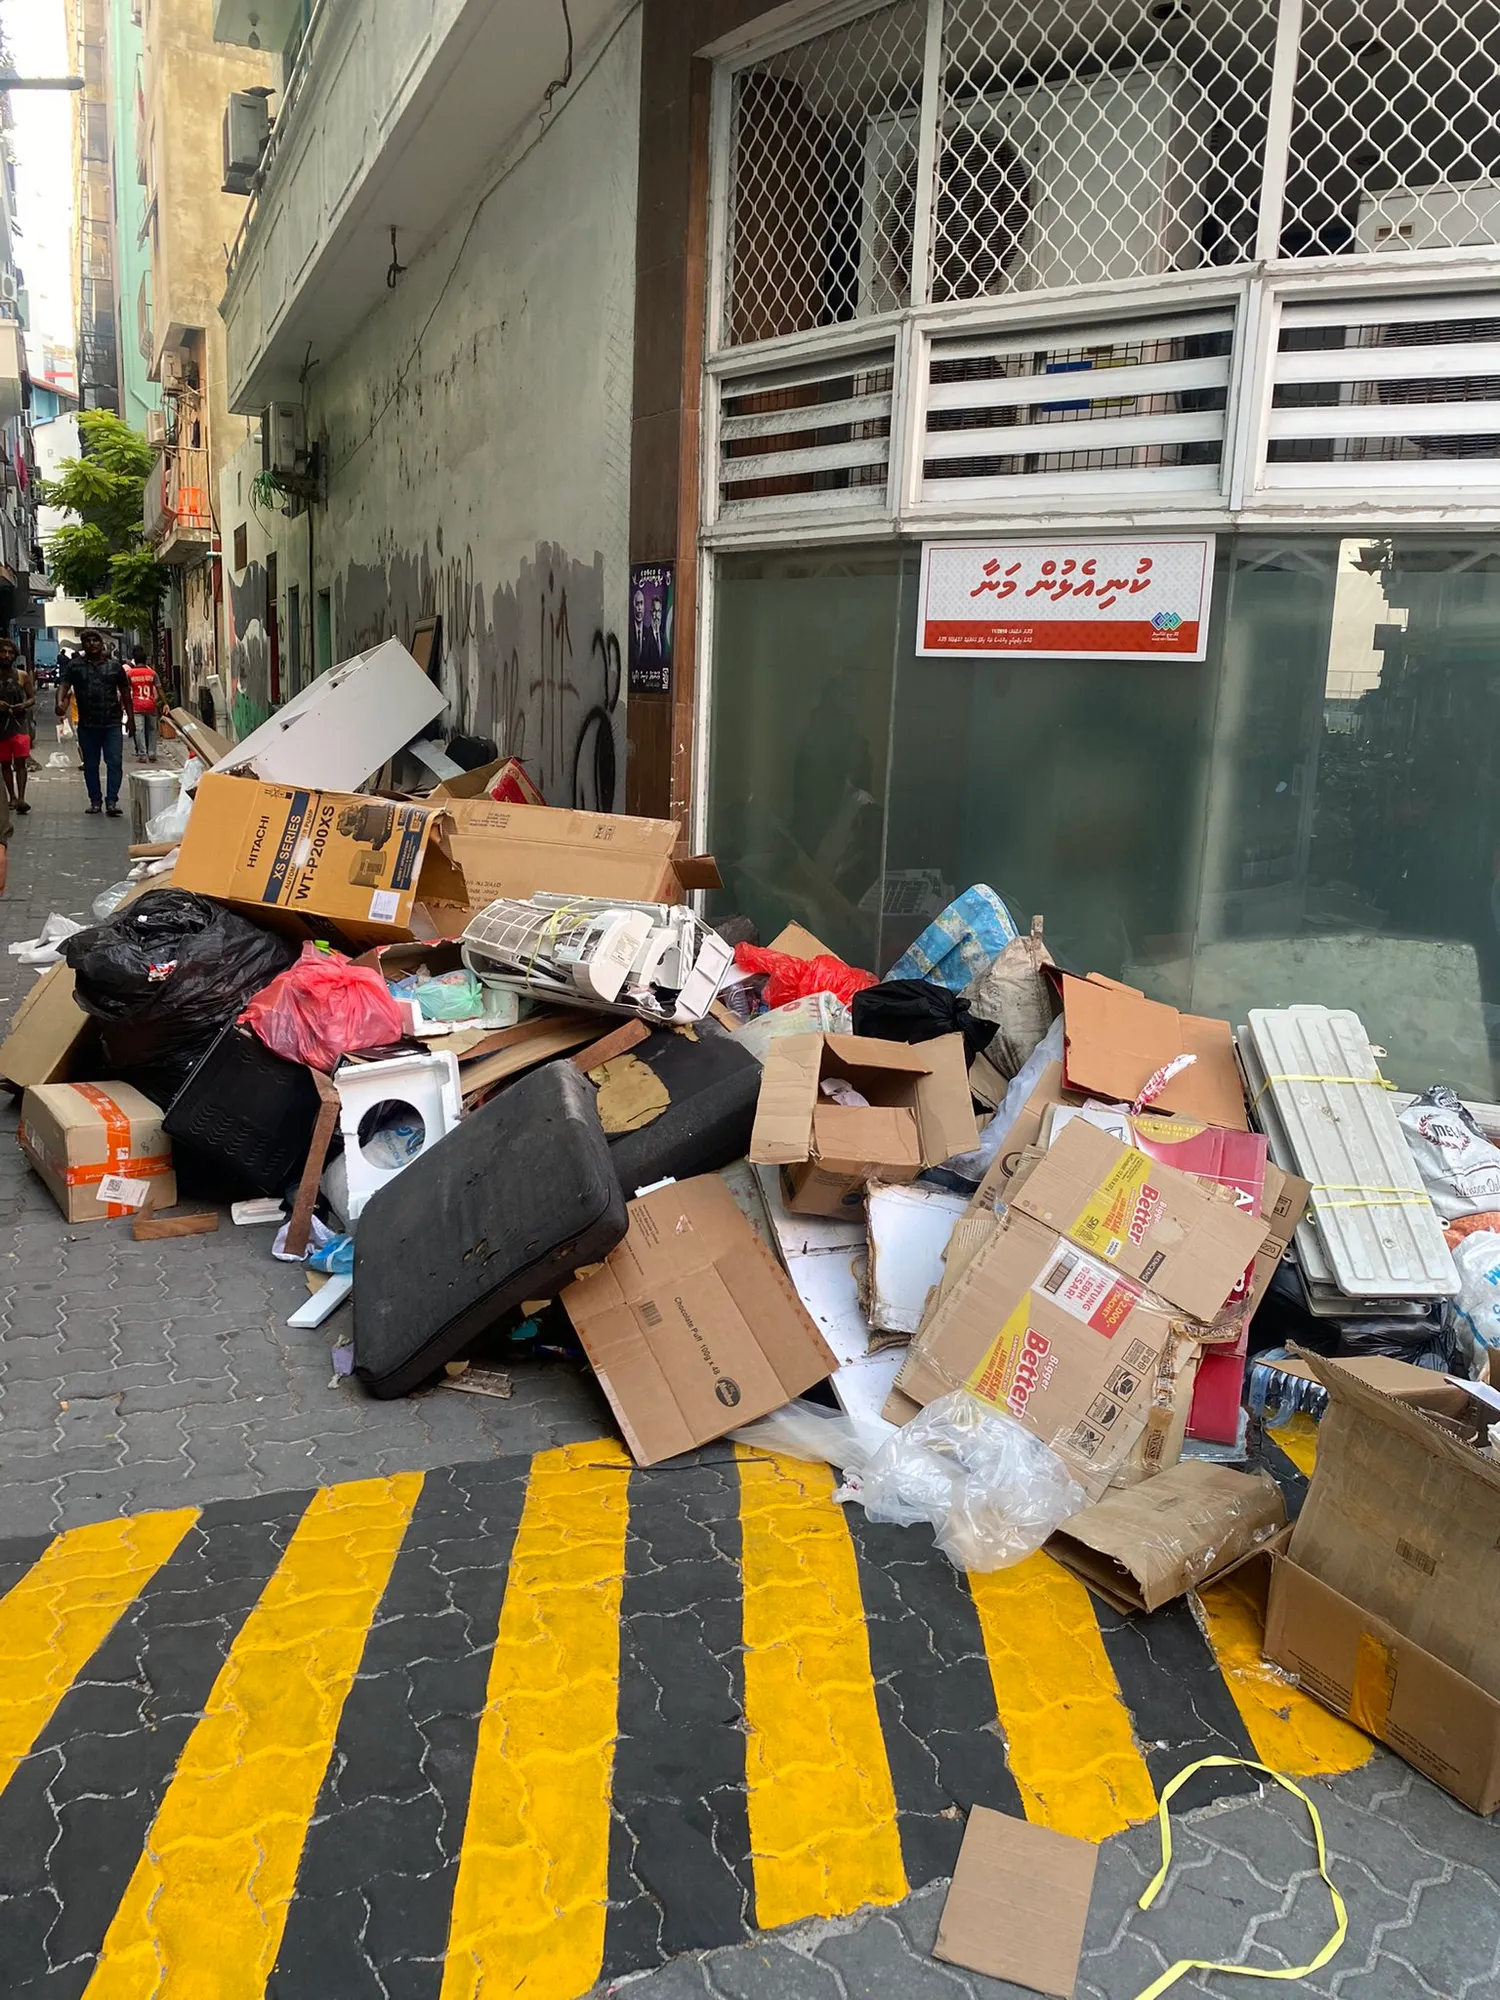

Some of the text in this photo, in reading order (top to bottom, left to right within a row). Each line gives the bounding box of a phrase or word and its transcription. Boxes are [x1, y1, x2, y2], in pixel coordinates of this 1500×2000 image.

[137, 685, 150, 700] 19
[304, 809, 313, 827] PUMP
[247, 815, 270, 868] HITACHI
[273, 815, 301, 880] XS SERIES
[295, 805, 335, 900] WT-P200XS
[1128, 1182, 1161, 1246] Better
[1064, 1266, 1091, 1300] BESAR!
[1076, 1277, 1096, 1301] LEBIH
[1082, 1278, 1109, 1311] UNTUNG
[674, 1297, 695, 1329] Chocolate
[691, 1328, 703, 1343] Puff
[700, 1343, 711, 1362] 100g
[712, 1364, 720, 1376] 48
[984, 1368, 1004, 1402] BESAR
[1007, 1327, 1052, 1419] Better
[1041, 1354, 1060, 1391] Bigger
